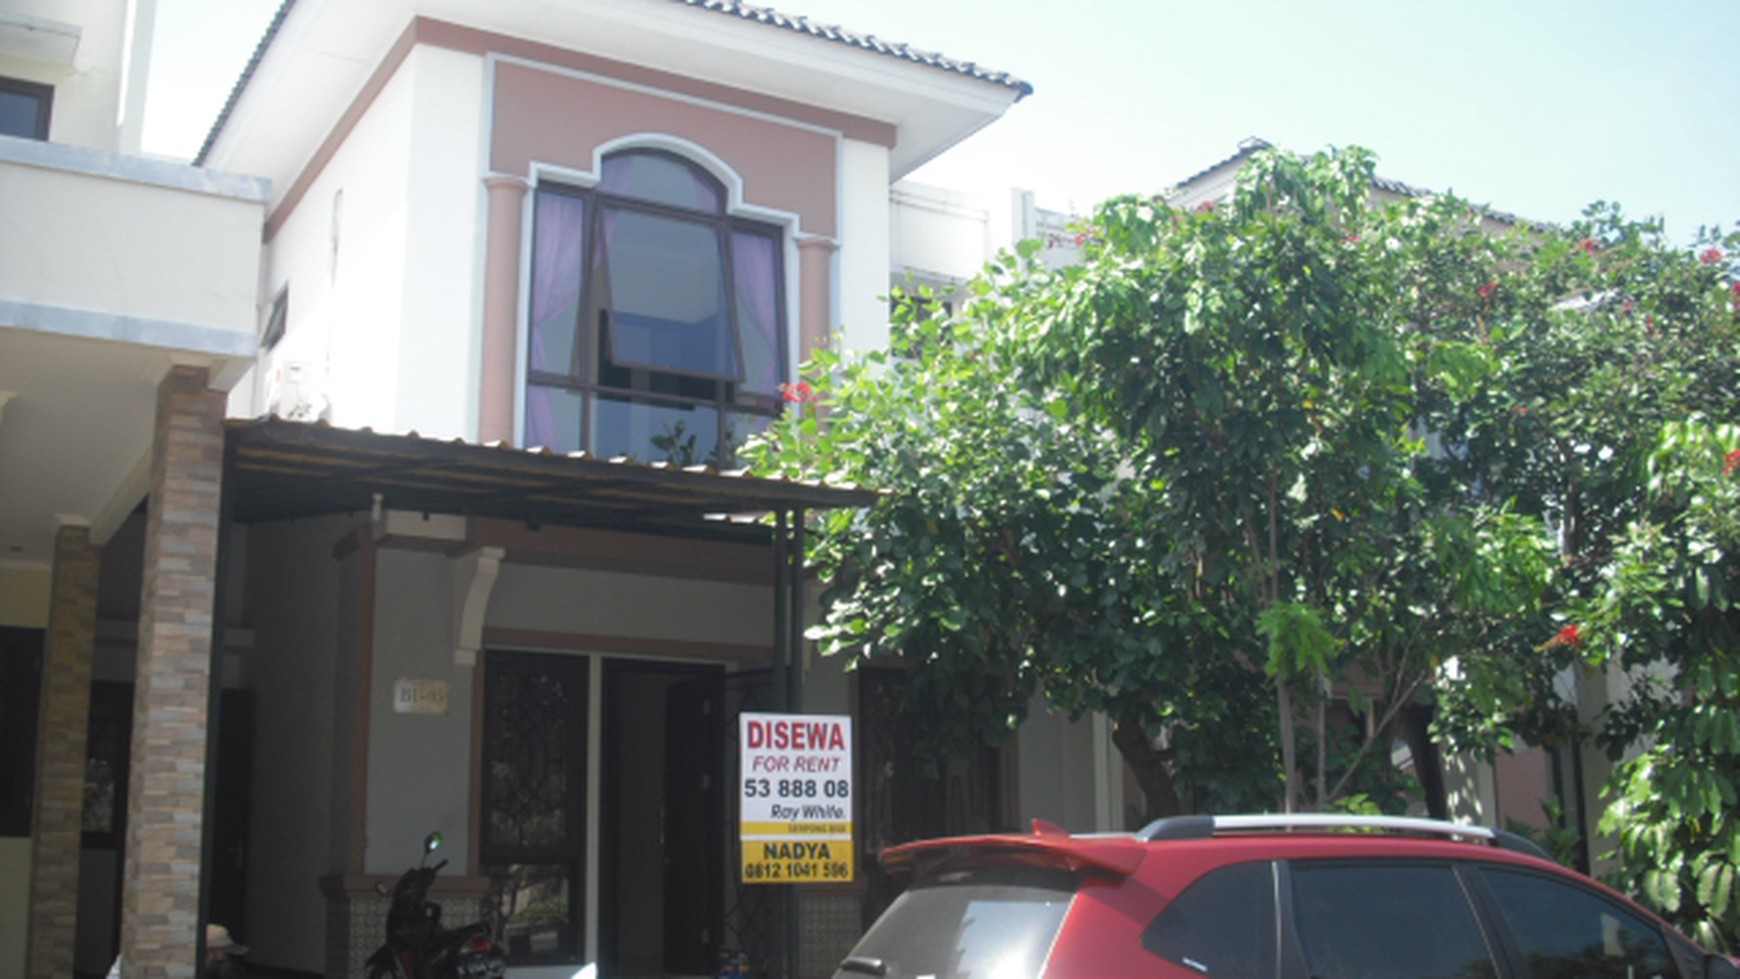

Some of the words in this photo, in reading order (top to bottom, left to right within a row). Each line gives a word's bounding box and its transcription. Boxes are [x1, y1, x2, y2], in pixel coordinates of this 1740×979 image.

[748, 720, 845, 750] DISEWA
[752, 755, 790, 773] FOR
[793, 756, 841, 773] RENT
[744, 778, 770, 798] 53
[778, 779, 817, 798] 888
[823, 779, 849, 798] 08
[771, 804, 799, 822] Ray
[763, 842, 831, 860] NADYA
[745, 862, 781, 878] 0812
[786, 862, 817, 878] 1041
